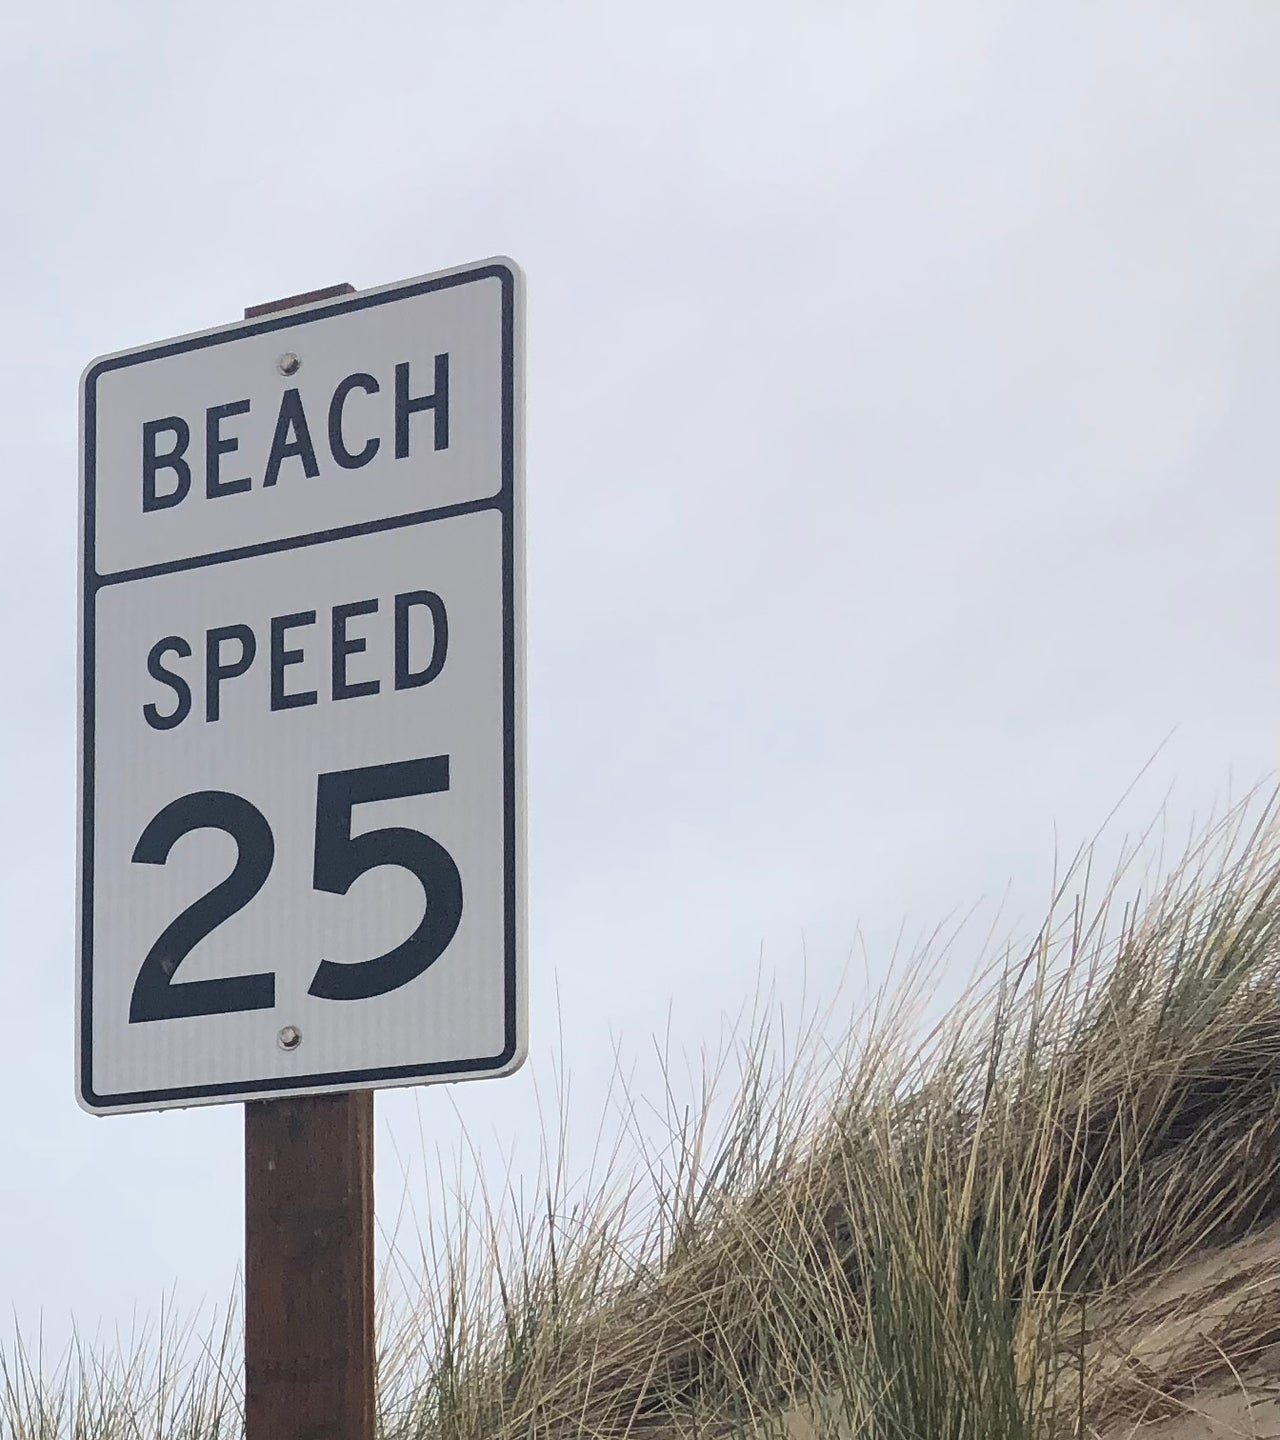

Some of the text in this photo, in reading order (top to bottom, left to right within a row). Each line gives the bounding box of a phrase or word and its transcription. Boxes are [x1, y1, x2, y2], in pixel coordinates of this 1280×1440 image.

[142, 352, 450, 514] BEACH
[142, 589, 449, 731] SPEED
[128, 754, 464, 1025] 25
